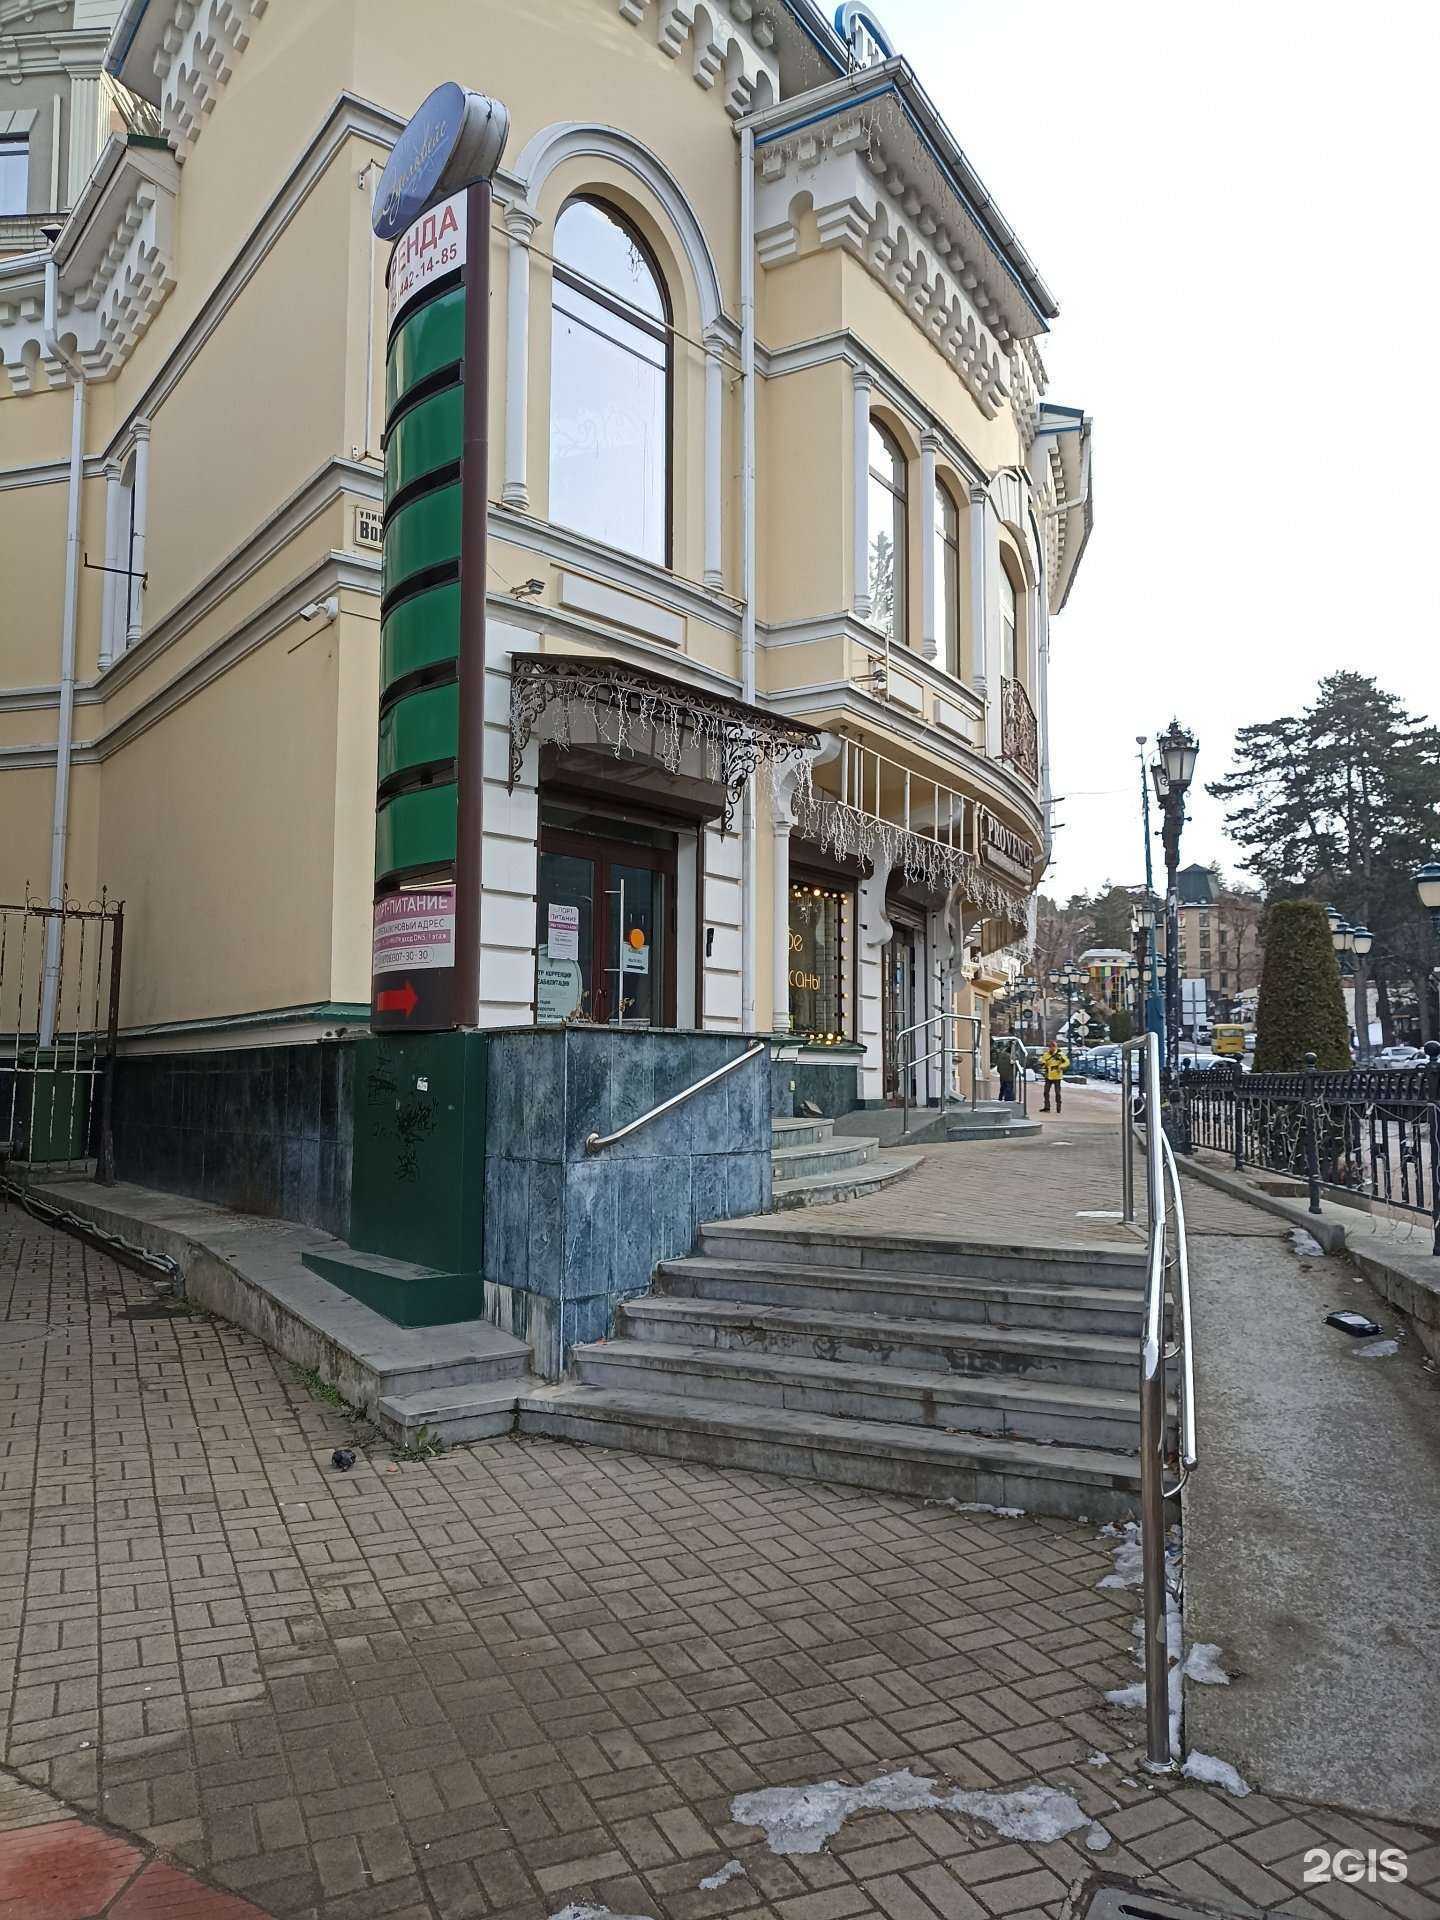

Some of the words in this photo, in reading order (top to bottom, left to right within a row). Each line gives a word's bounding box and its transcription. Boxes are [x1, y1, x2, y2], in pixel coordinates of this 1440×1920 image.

[388, 205, 459, 284] РЕНДА
[359, 511, 383, 523] УЛИЦ
[417, 918, 445, 931] АДРЕС
